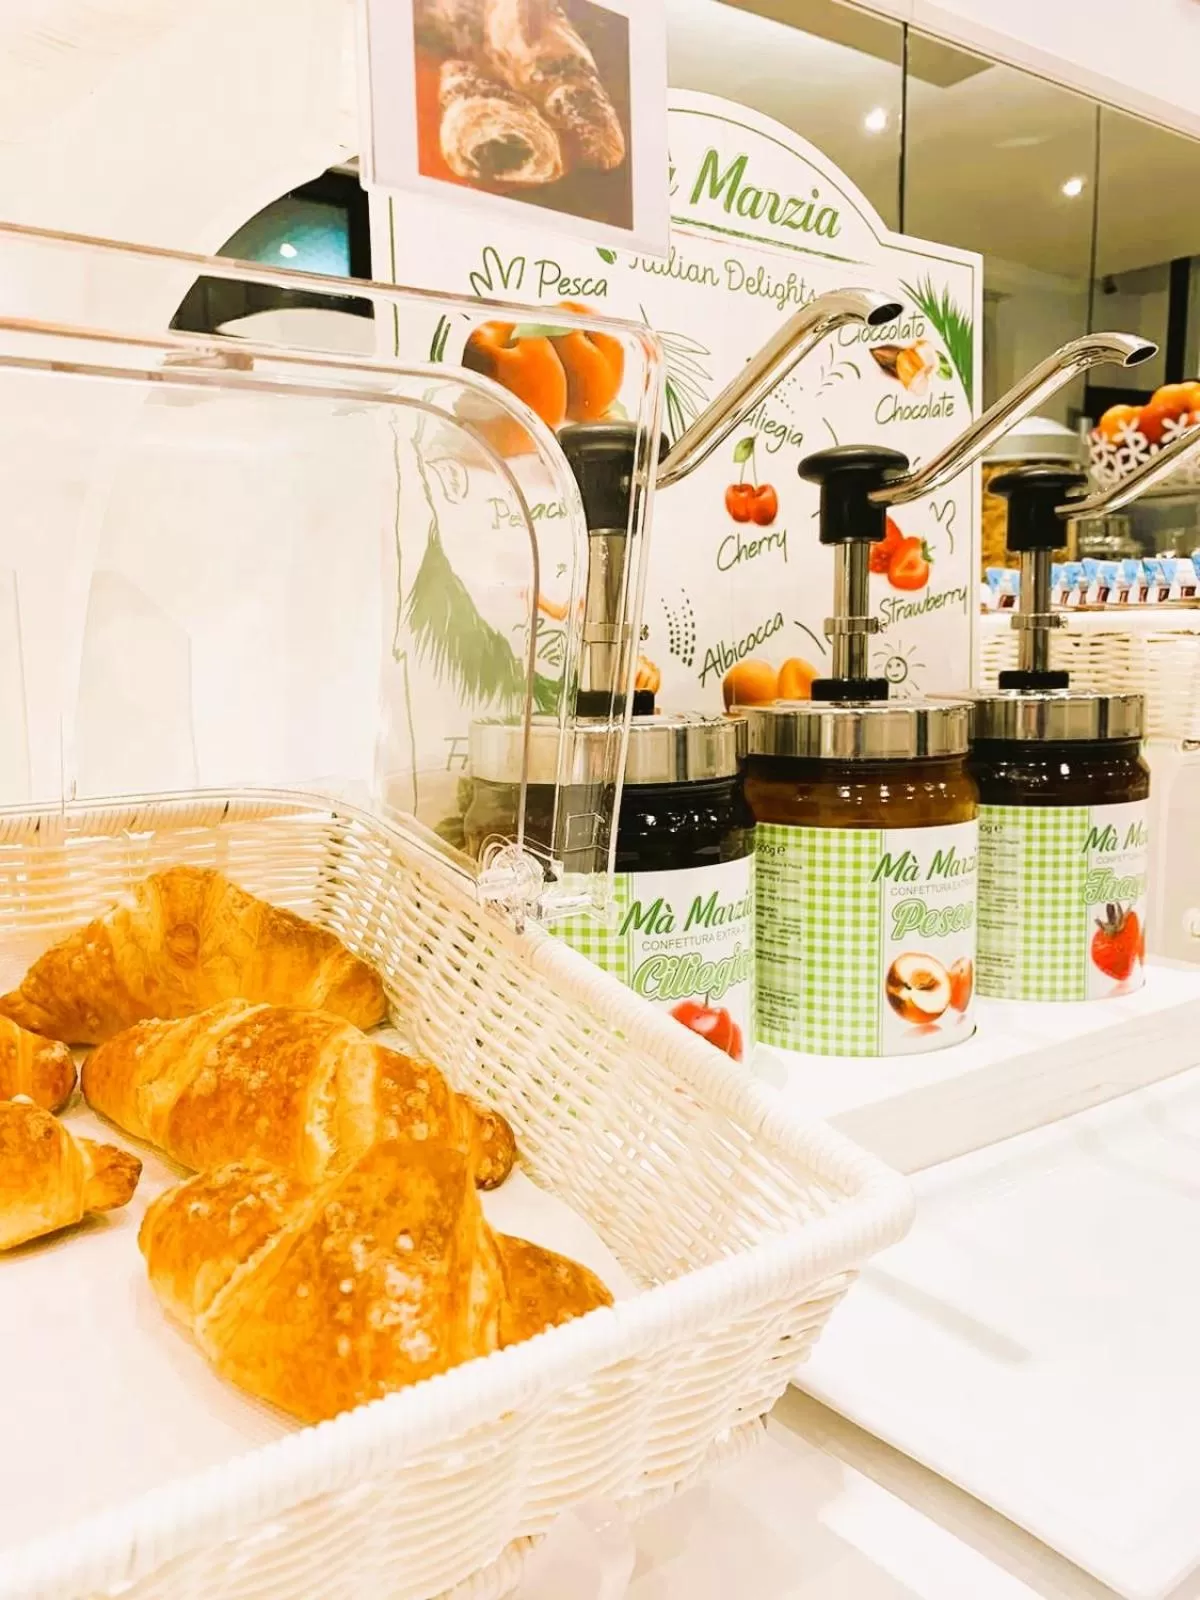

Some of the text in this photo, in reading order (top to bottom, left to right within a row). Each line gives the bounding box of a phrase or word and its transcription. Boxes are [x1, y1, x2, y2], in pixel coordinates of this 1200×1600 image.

[690, 149, 841, 239] Marzia
[534, 259, 607, 298] Pesca
[724, 259, 815, 310] Delights
[838, 311, 925, 347] Cioccolato
[875, 391, 955, 425] Chocolate
[743, 403, 804, 453] iliegia
[717, 529, 788, 571] Cherry
[879, 585, 967, 624] Strawberry
[698, 611, 785, 688] Albicocca
[1082, 824, 1118, 853] Mà
[871, 851, 919, 882] Mà
[619, 898, 675, 936] Mà
[641, 932, 715, 951] CONFETTURA
